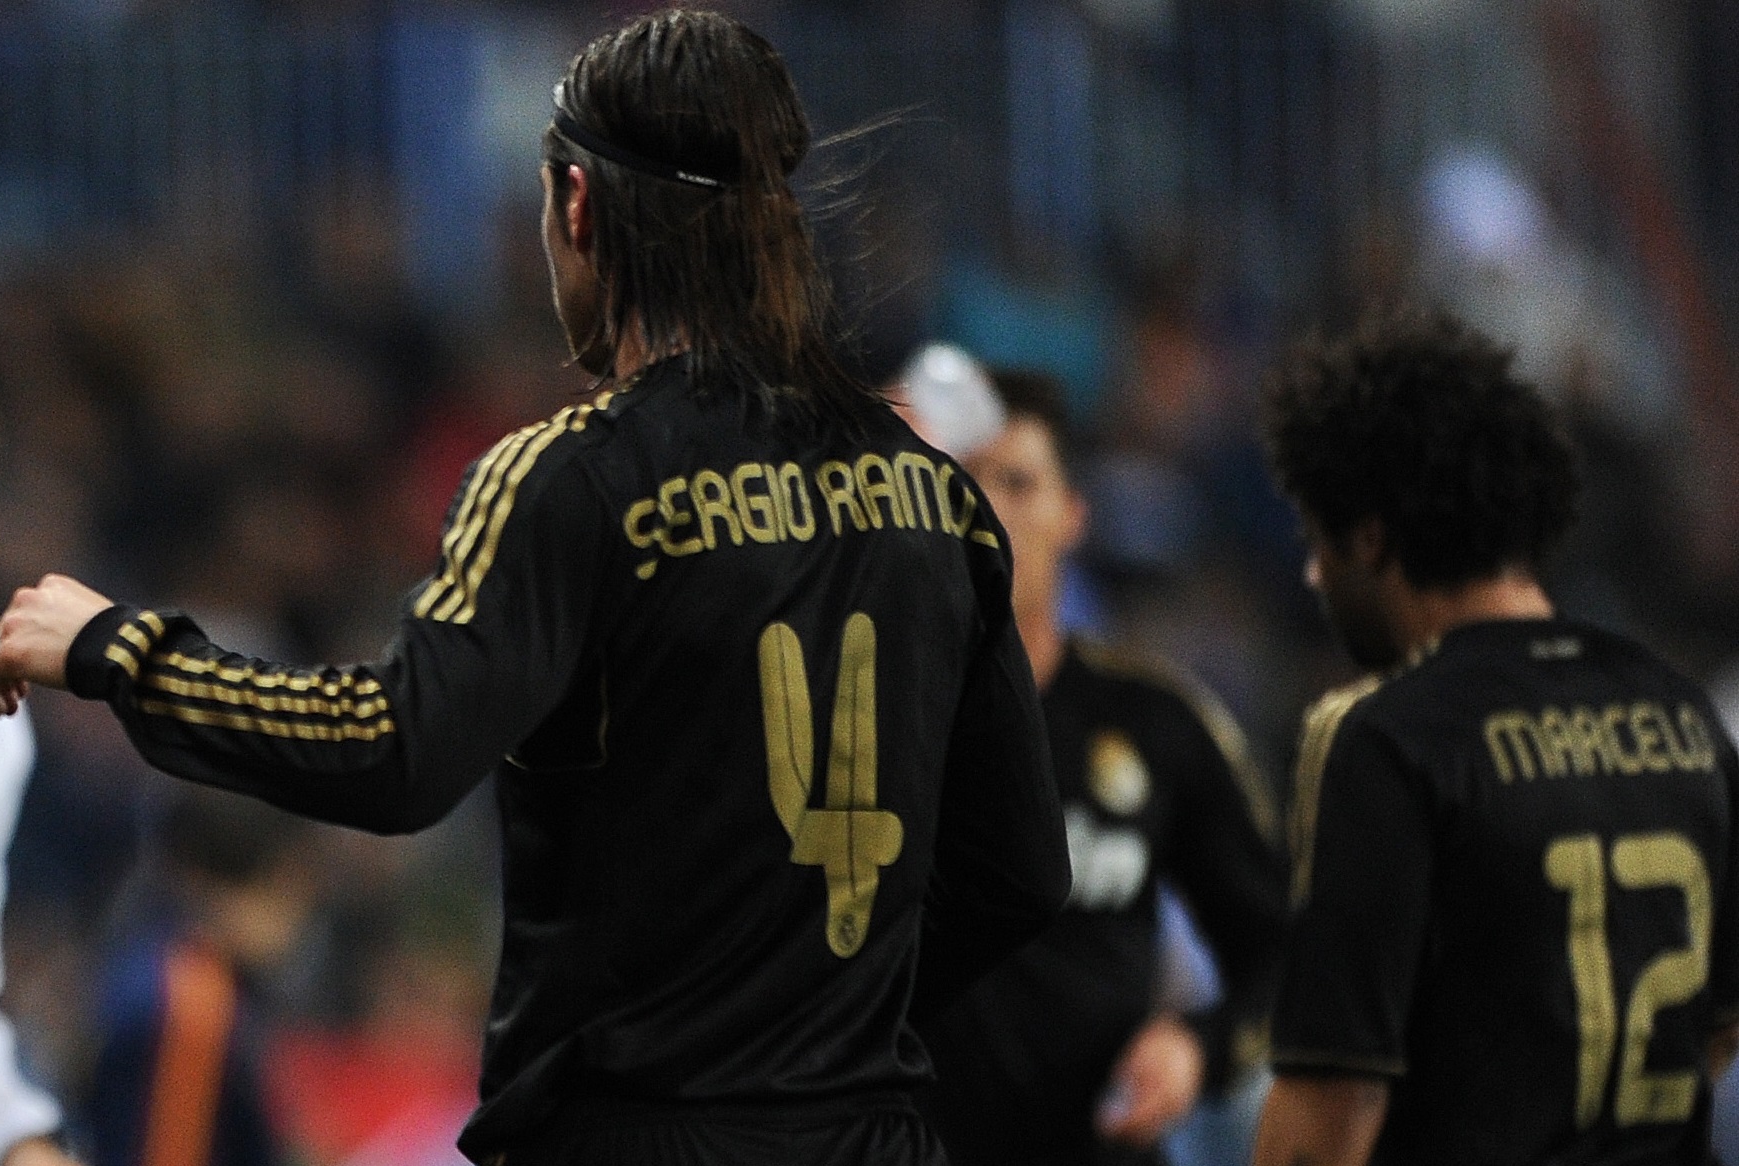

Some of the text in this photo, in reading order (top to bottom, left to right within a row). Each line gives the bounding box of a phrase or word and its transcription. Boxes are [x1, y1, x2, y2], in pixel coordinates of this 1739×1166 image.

[623, 451, 1000, 581] SERGIO RAMO
[758, 611, 904, 960] 4
[1543, 830, 1714, 1130] 12
